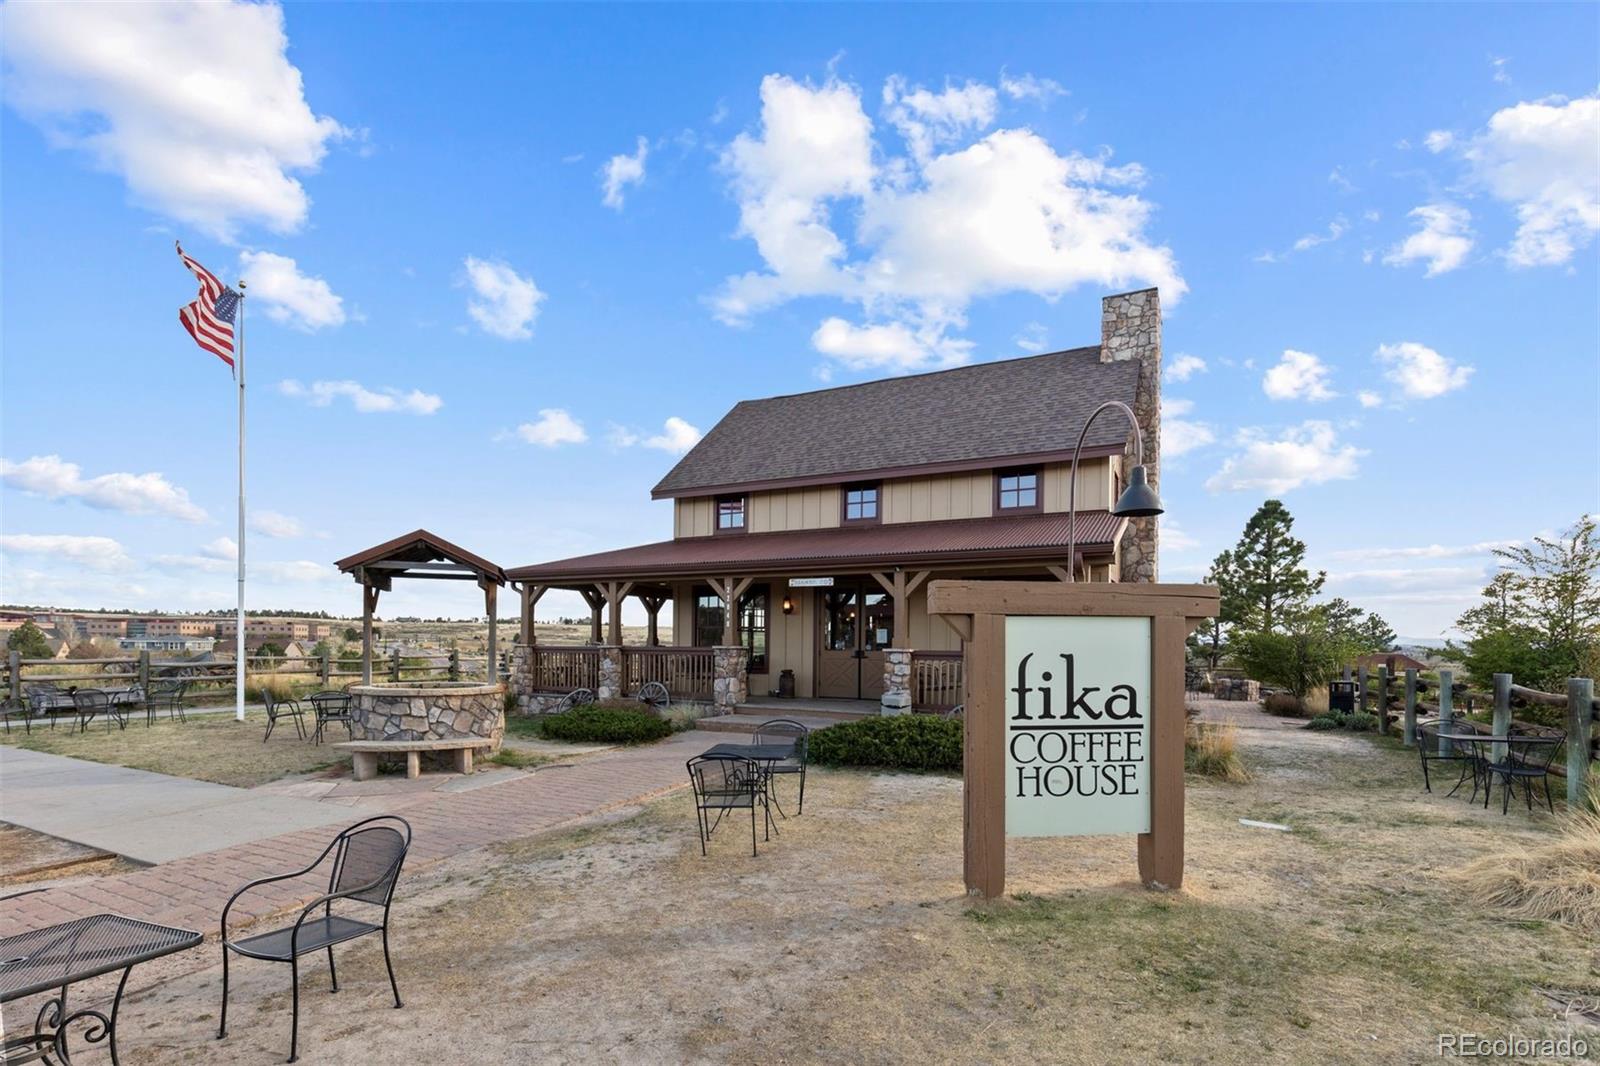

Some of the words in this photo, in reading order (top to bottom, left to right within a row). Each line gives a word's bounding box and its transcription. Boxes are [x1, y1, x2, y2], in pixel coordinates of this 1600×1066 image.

[1011, 652, 1143, 720] fika
[1010, 732, 1144, 764] COFFEE
[1016, 764, 1139, 797] HOUSE
